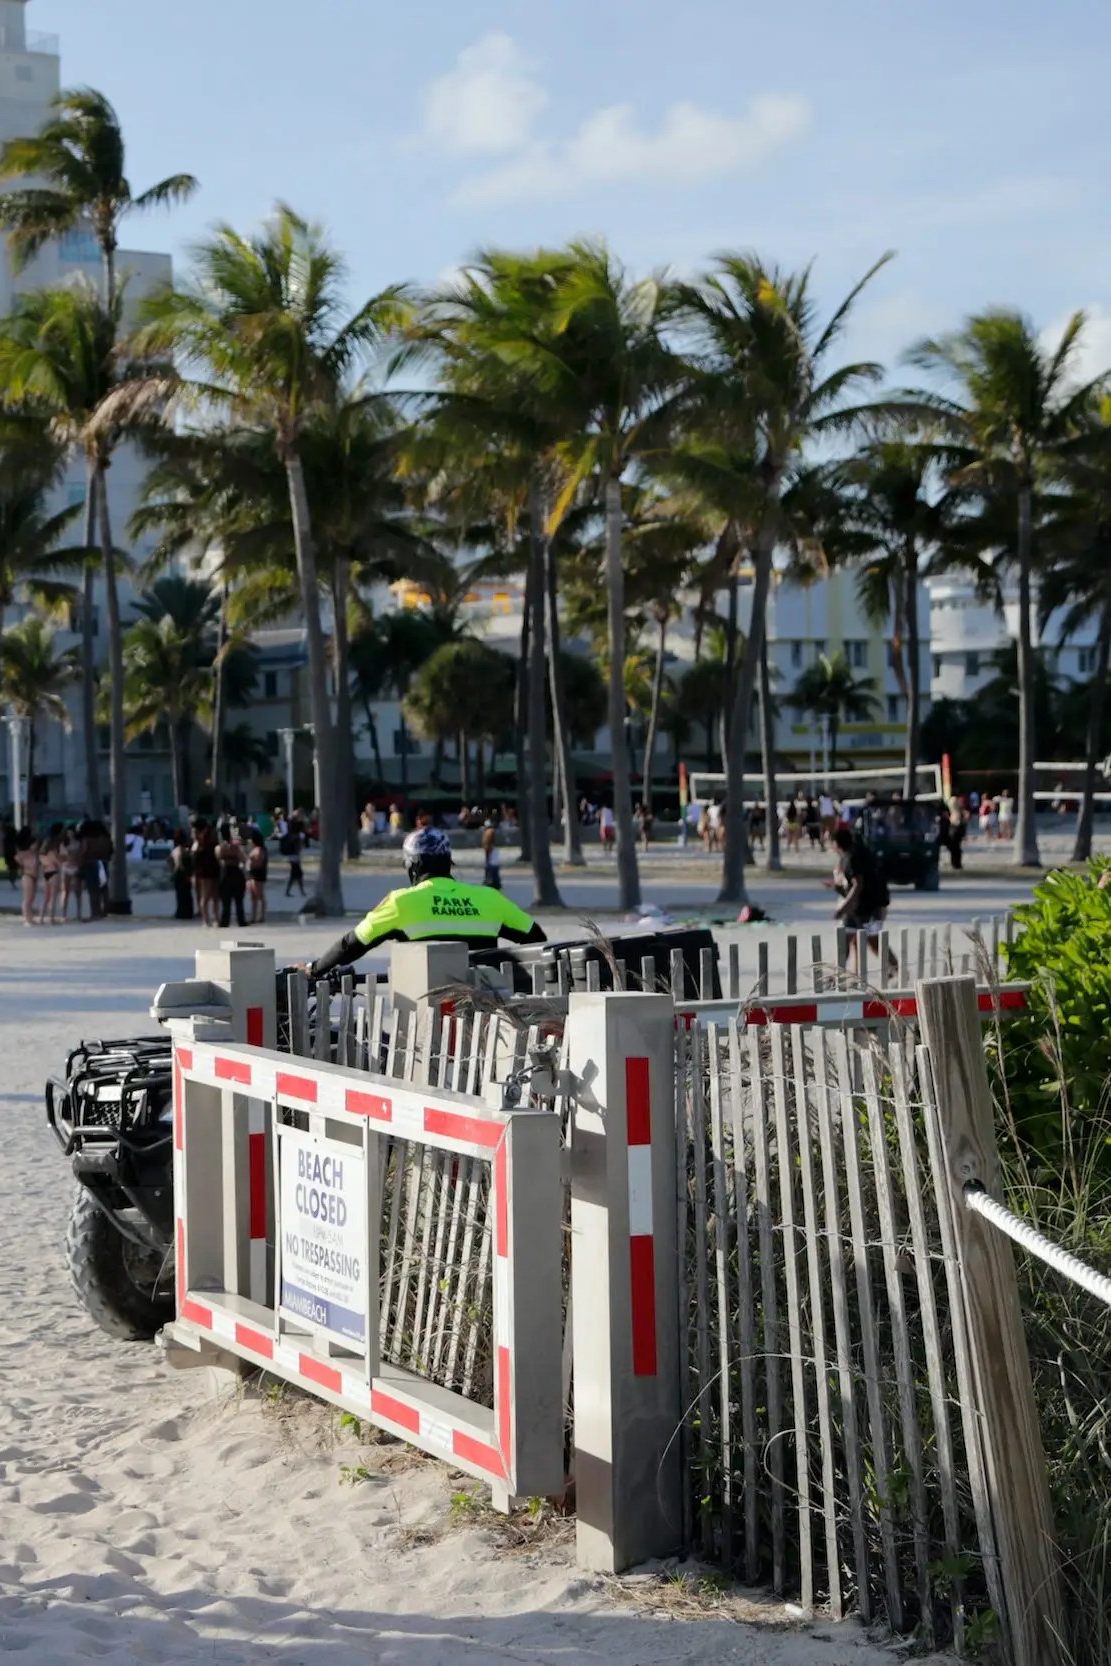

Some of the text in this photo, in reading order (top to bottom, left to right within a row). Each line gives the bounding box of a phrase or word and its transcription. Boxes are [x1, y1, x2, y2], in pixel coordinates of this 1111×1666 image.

[431, 906, 480, 916] RANGER
[432, 895, 473, 907] PARK
[297, 1148, 343, 1190] BEACH
[295, 1183, 347, 1227] CLOSED
[286, 1232, 299, 1257] NO
[301, 1239, 360, 1282] TRESPASSING
